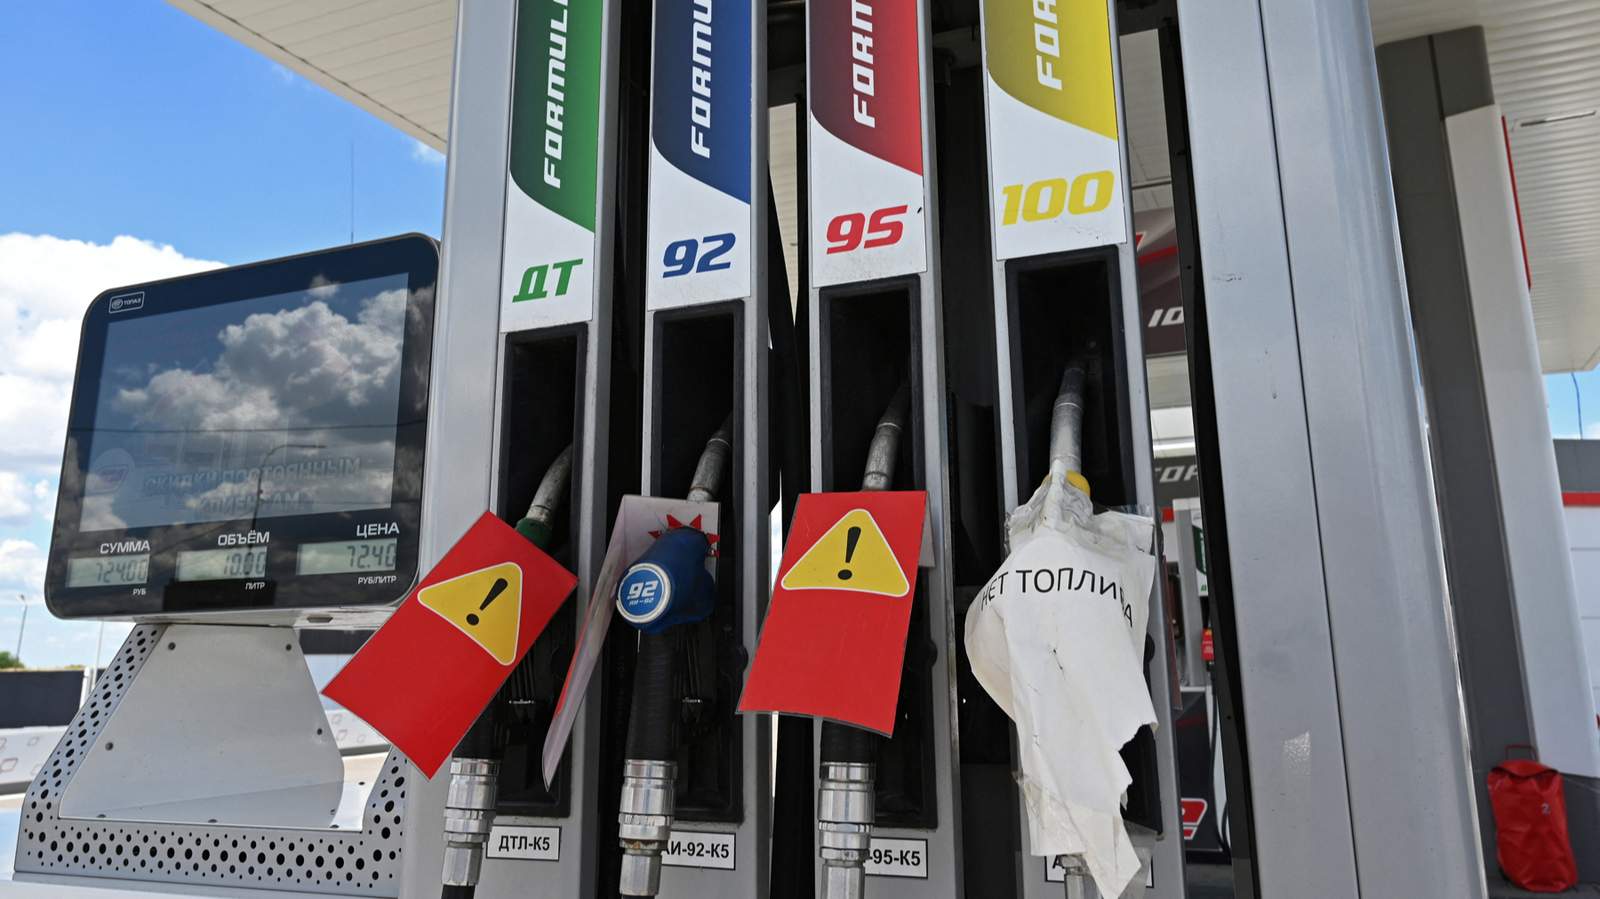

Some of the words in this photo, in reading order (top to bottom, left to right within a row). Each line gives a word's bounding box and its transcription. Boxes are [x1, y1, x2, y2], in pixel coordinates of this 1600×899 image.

[544, 0, 569, 189] FORMUL
[1002, 170, 1115, 226] 100
[826, 205, 908, 255] 95
[662, 233, 736, 278] 92
[512, 258, 584, 303] ДТ
[217, 531, 270, 546] ОБЪЁМ
[356, 522, 400, 538] ЦЕНА
[100, 539, 151, 554] СУММА
[348, 543, 396, 569] 72.40
[357, 574, 397, 585] РУБ/ЛИТР
[627, 580, 659, 600] 92
[981, 571, 1009, 611] НЕТ
[132, 587, 147, 596] РУБ
[498, 835, 551, 852] ДТЛ-К5
